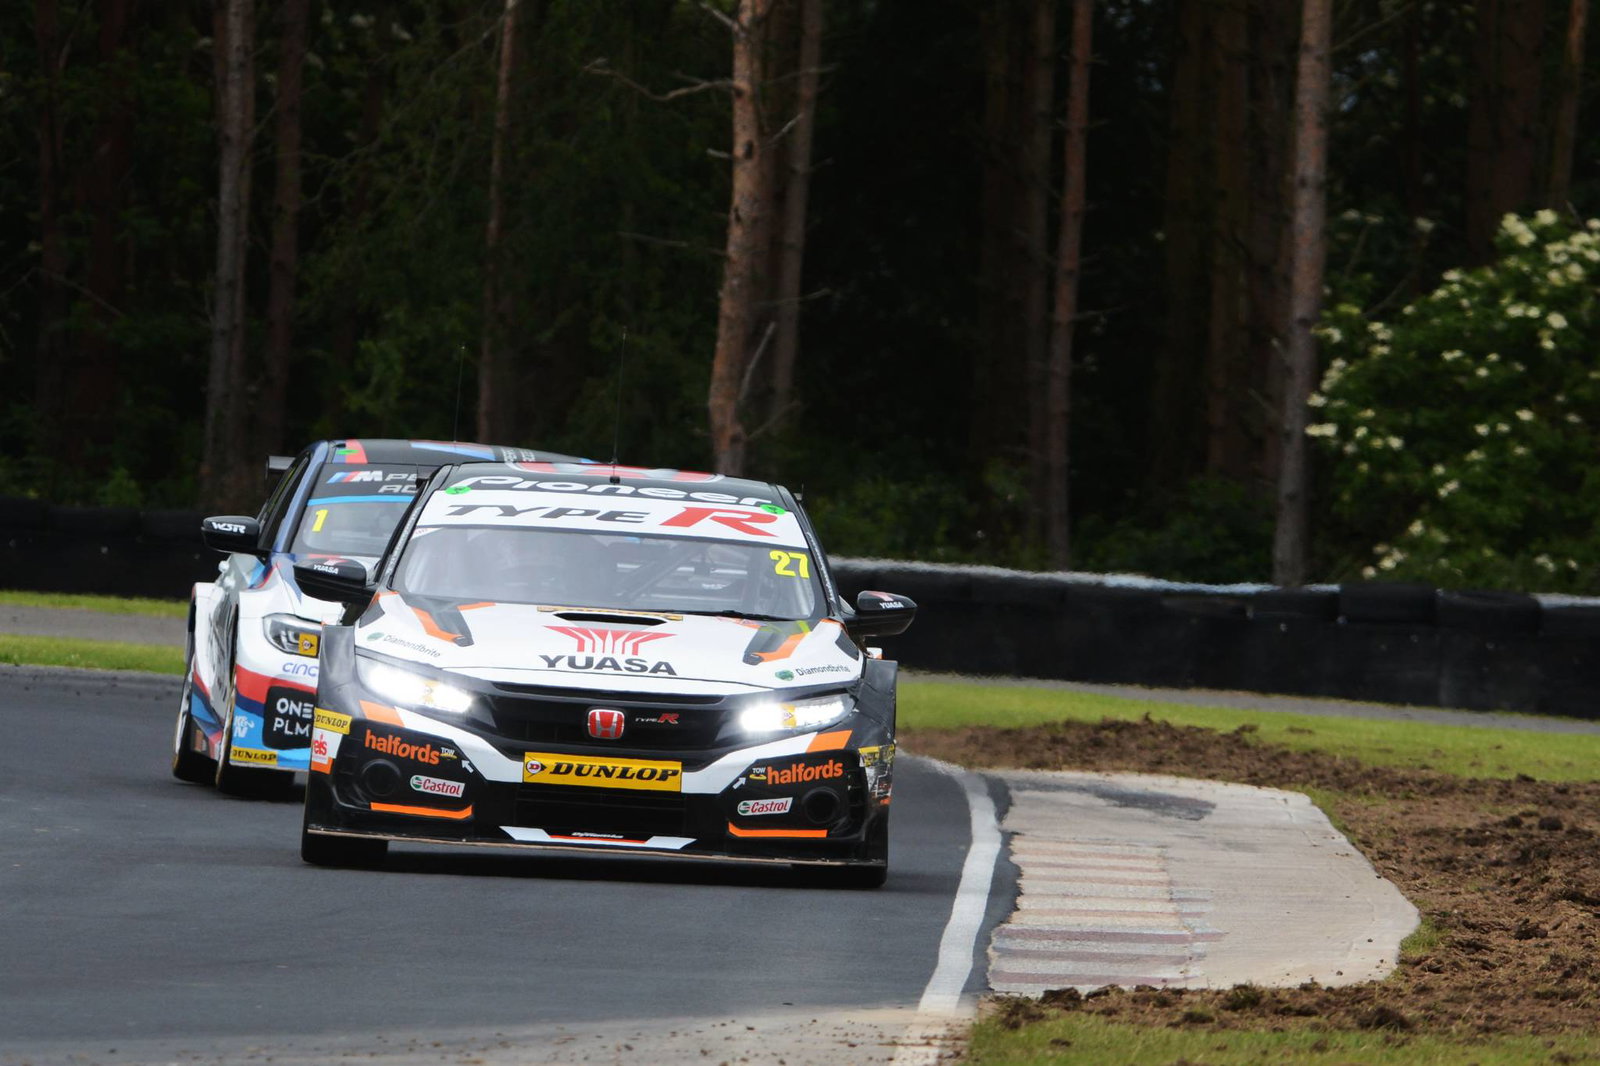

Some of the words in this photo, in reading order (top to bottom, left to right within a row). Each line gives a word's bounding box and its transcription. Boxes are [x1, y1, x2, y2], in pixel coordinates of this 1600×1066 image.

[453, 475, 773, 507] Pioneer
[311, 508, 329, 533] 1
[446, 504, 645, 524] TYPE
[660, 506, 780, 538] R
[312, 563, 339, 575] YUASA
[769, 550, 811, 579] 27
[879, 601, 904, 609] YUASA
[383, 634, 443, 659] Diamondbrite
[538, 654, 678, 677] YUASA
[275, 697, 314, 719] ONE
[272, 717, 311, 737] PLM
[315, 714, 349, 729] DUNLOP
[232, 748, 277, 763] DUNLOP
[364, 729, 441, 765] halfords
[550, 761, 680, 782] DUNLOP
[751, 766, 766, 775] TOW
[767, 759, 844, 785] halfords
[422, 778, 462, 796] Castrol
[750, 799, 789, 813] Castrol
